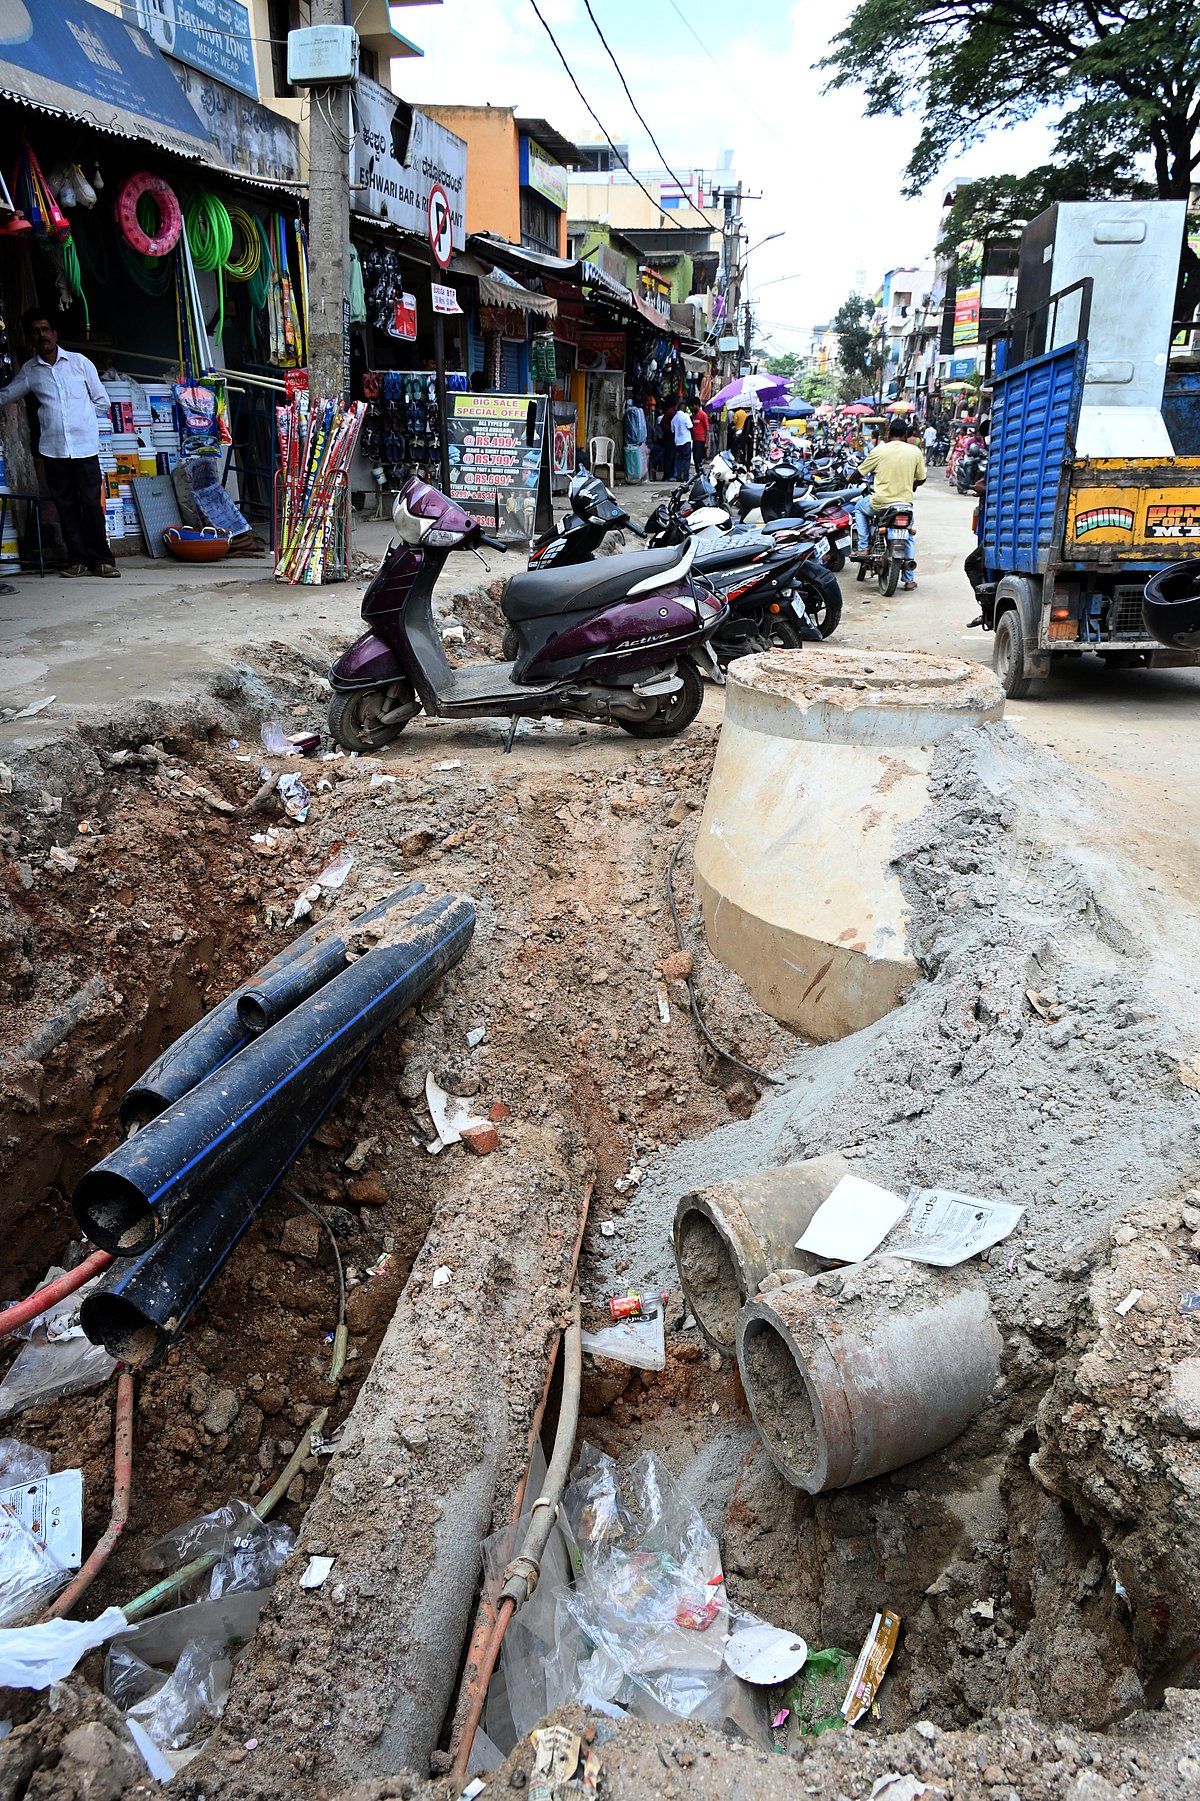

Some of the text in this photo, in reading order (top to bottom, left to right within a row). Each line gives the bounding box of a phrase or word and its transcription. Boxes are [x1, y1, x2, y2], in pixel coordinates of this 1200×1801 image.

[178, 5, 223, 49] FASHION
[224, 36, 250, 65] ZONE
[197, 42, 218, 62] MEN'S
[221, 55, 239, 74] WEAR
[360, 168, 397, 198] ESHWARI
[399, 187, 414, 205] BAR
[416, 195, 420, 208] &
[473, 398, 490, 406] BIG
[456, 408, 497, 416] SPECIAL
[476, 436, 521, 448] RS.499/-
[475, 454, 519, 466] RS.799/-
[475, 473, 514, 486] RS.699/-
[1076, 508, 1133, 536] SOUND
[615, 632, 670, 650] Activa
